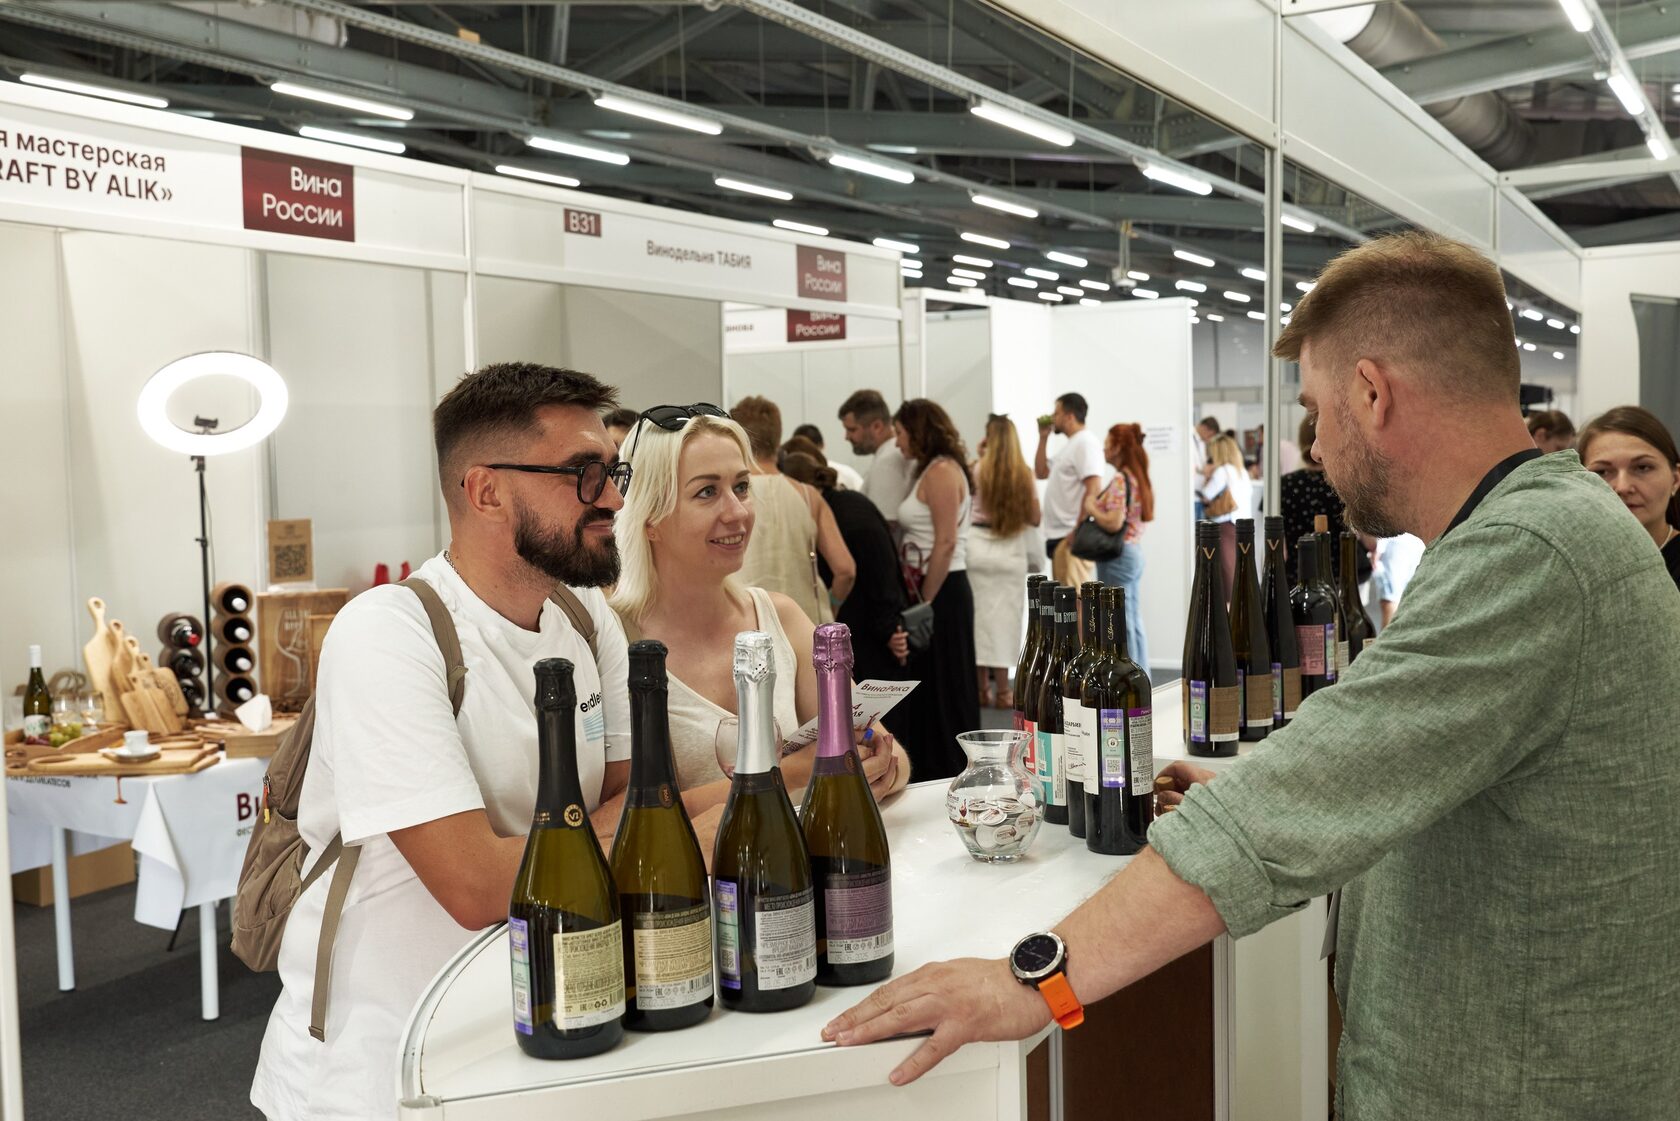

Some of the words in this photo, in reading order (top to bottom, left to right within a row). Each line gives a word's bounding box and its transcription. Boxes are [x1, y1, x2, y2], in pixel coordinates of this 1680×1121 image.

[16, 132, 165, 172] мастерская
[65, 167, 98, 192] BY
[106, 174, 173, 201] ALIK»
[290, 166, 342, 198] Вина
[262, 192, 343, 228] России
[646, 240, 714, 264] Винодельня
[717, 250, 752, 269] ТАБИЯ
[816, 254, 842, 274] Вина
[804, 273, 842, 294] России
[795, 324, 841, 336] России
